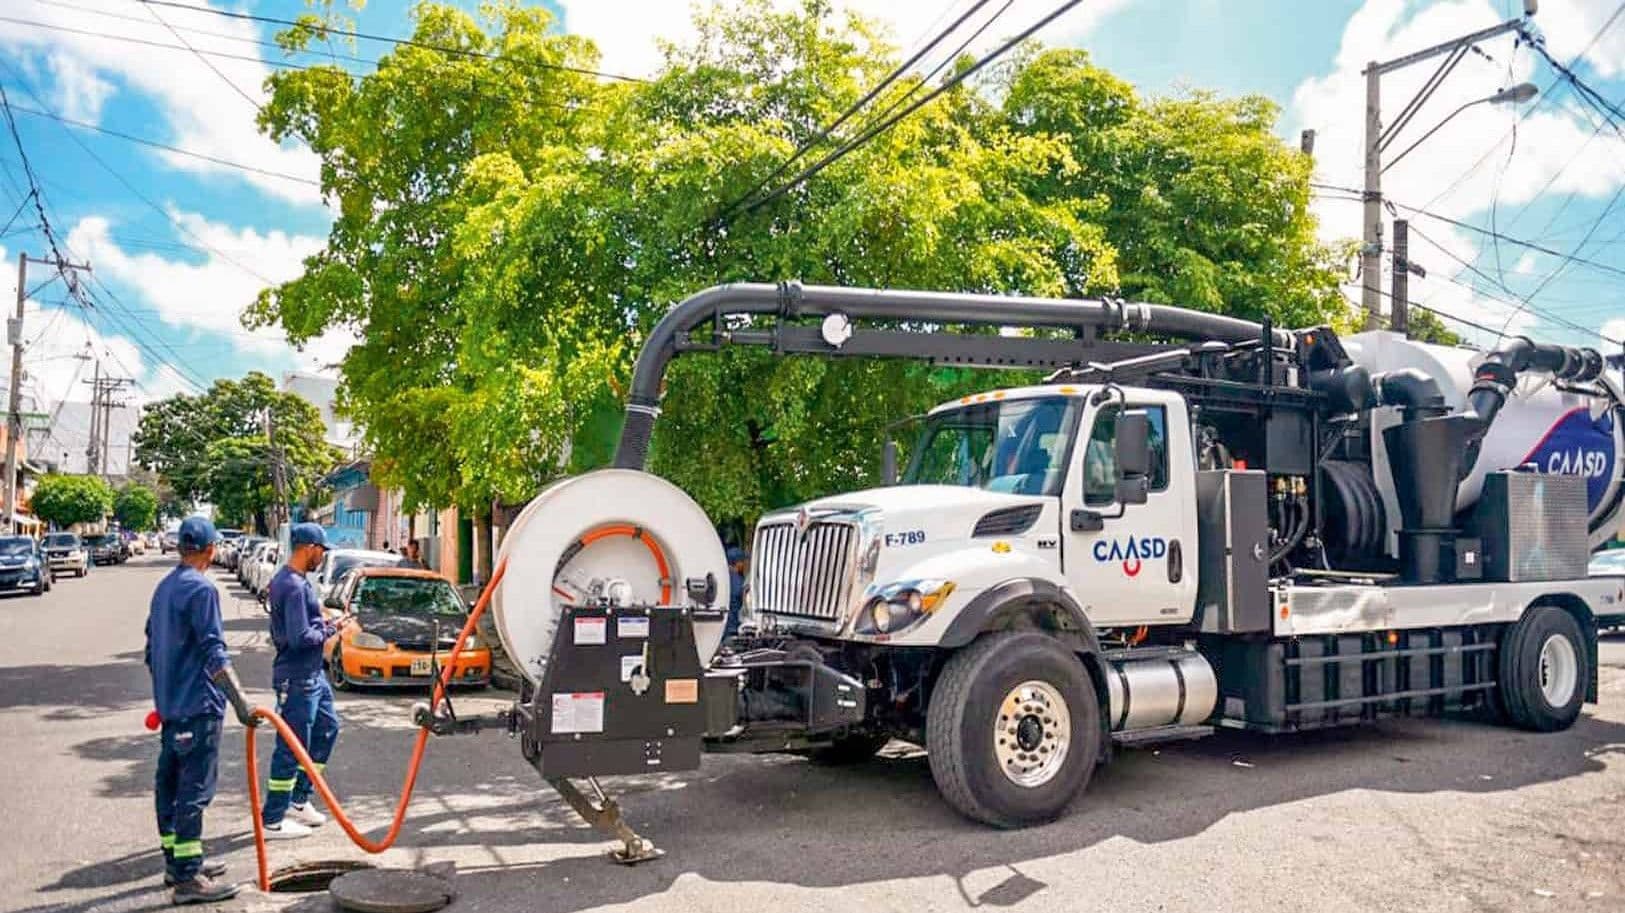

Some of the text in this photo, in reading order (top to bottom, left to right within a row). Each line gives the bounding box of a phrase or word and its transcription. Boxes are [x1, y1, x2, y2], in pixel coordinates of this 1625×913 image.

[1548, 446, 1606, 477] CAASD
[885, 530, 925, 547] F-789
[1093, 534, 1166, 561] CAASD
